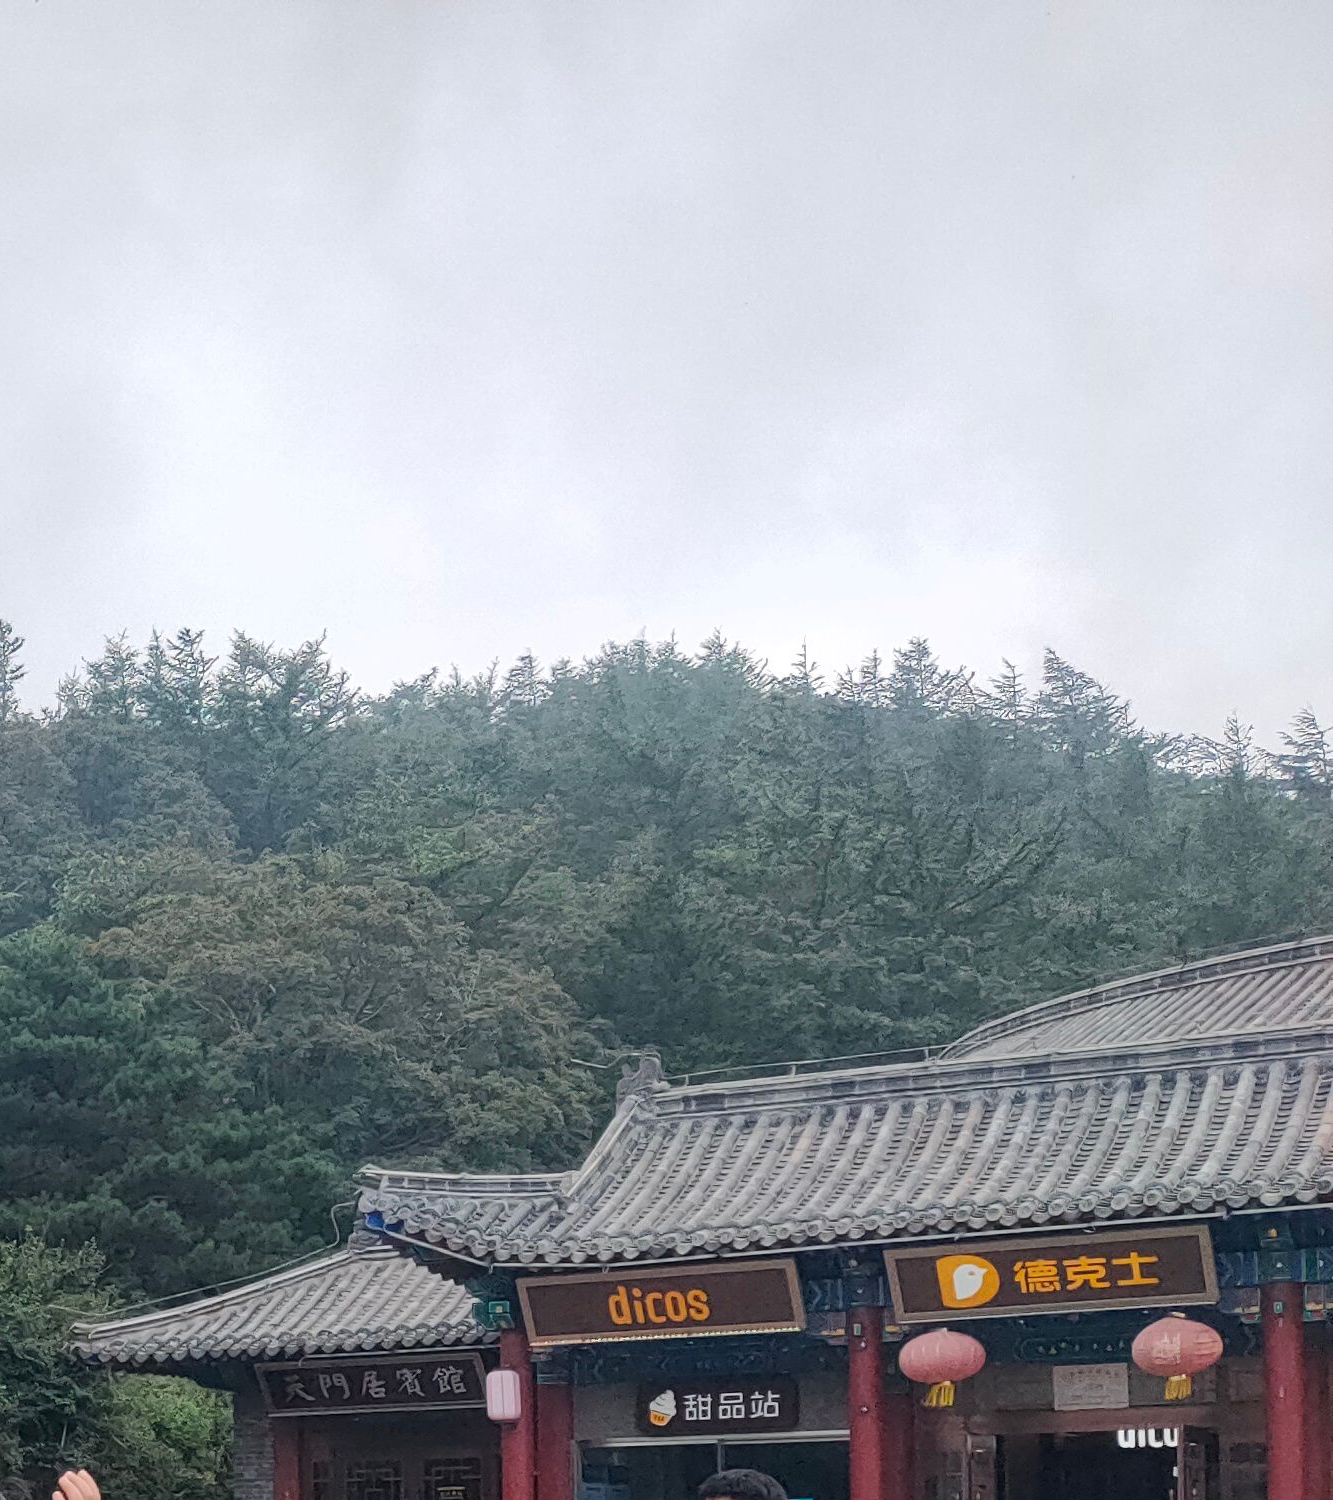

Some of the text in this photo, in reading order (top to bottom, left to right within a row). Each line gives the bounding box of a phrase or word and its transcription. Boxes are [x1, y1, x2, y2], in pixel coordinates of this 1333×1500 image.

[1012, 1251, 1160, 1294] 德克士
[607, 1285, 711, 1325] dicos
[683, 1390, 781, 1421] 甜品站
